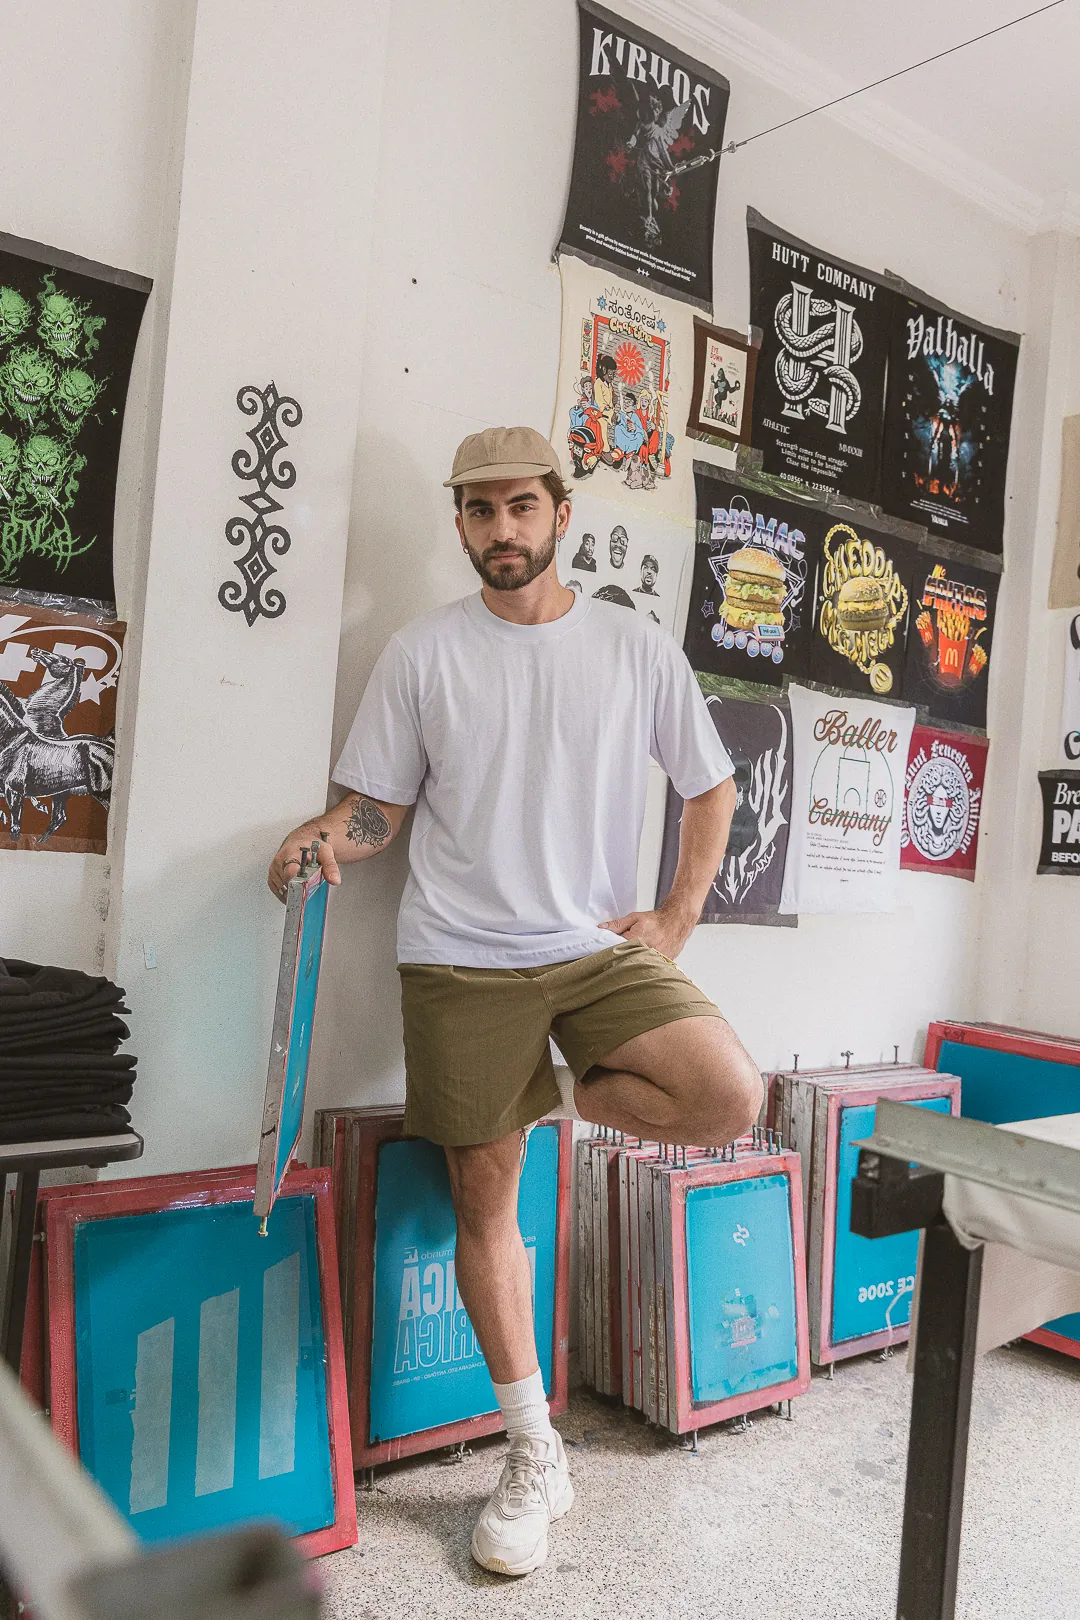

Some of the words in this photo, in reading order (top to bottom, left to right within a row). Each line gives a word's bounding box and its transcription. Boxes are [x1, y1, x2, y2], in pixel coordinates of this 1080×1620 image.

[771, 242, 810, 273] HUTT
[817, 263, 876, 301] COMPANY
[906, 315, 995, 396] Valhalla
[762, 418, 791, 435] ATHLETIC
[775, 438, 799, 451] Strength
[798, 447, 814, 457] comes
[814, 451, 827, 461] from
[827, 456, 849, 468] struggle.
[781, 448, 797, 459] Limits
[785, 457, 800, 467] Chase
[800, 462, 810, 471] the
[810, 465, 838, 479] impossible.
[813, 709, 898, 754] Baller
[808, 794, 891, 847] Company
[1051, 851, 1080, 863] BEFO
